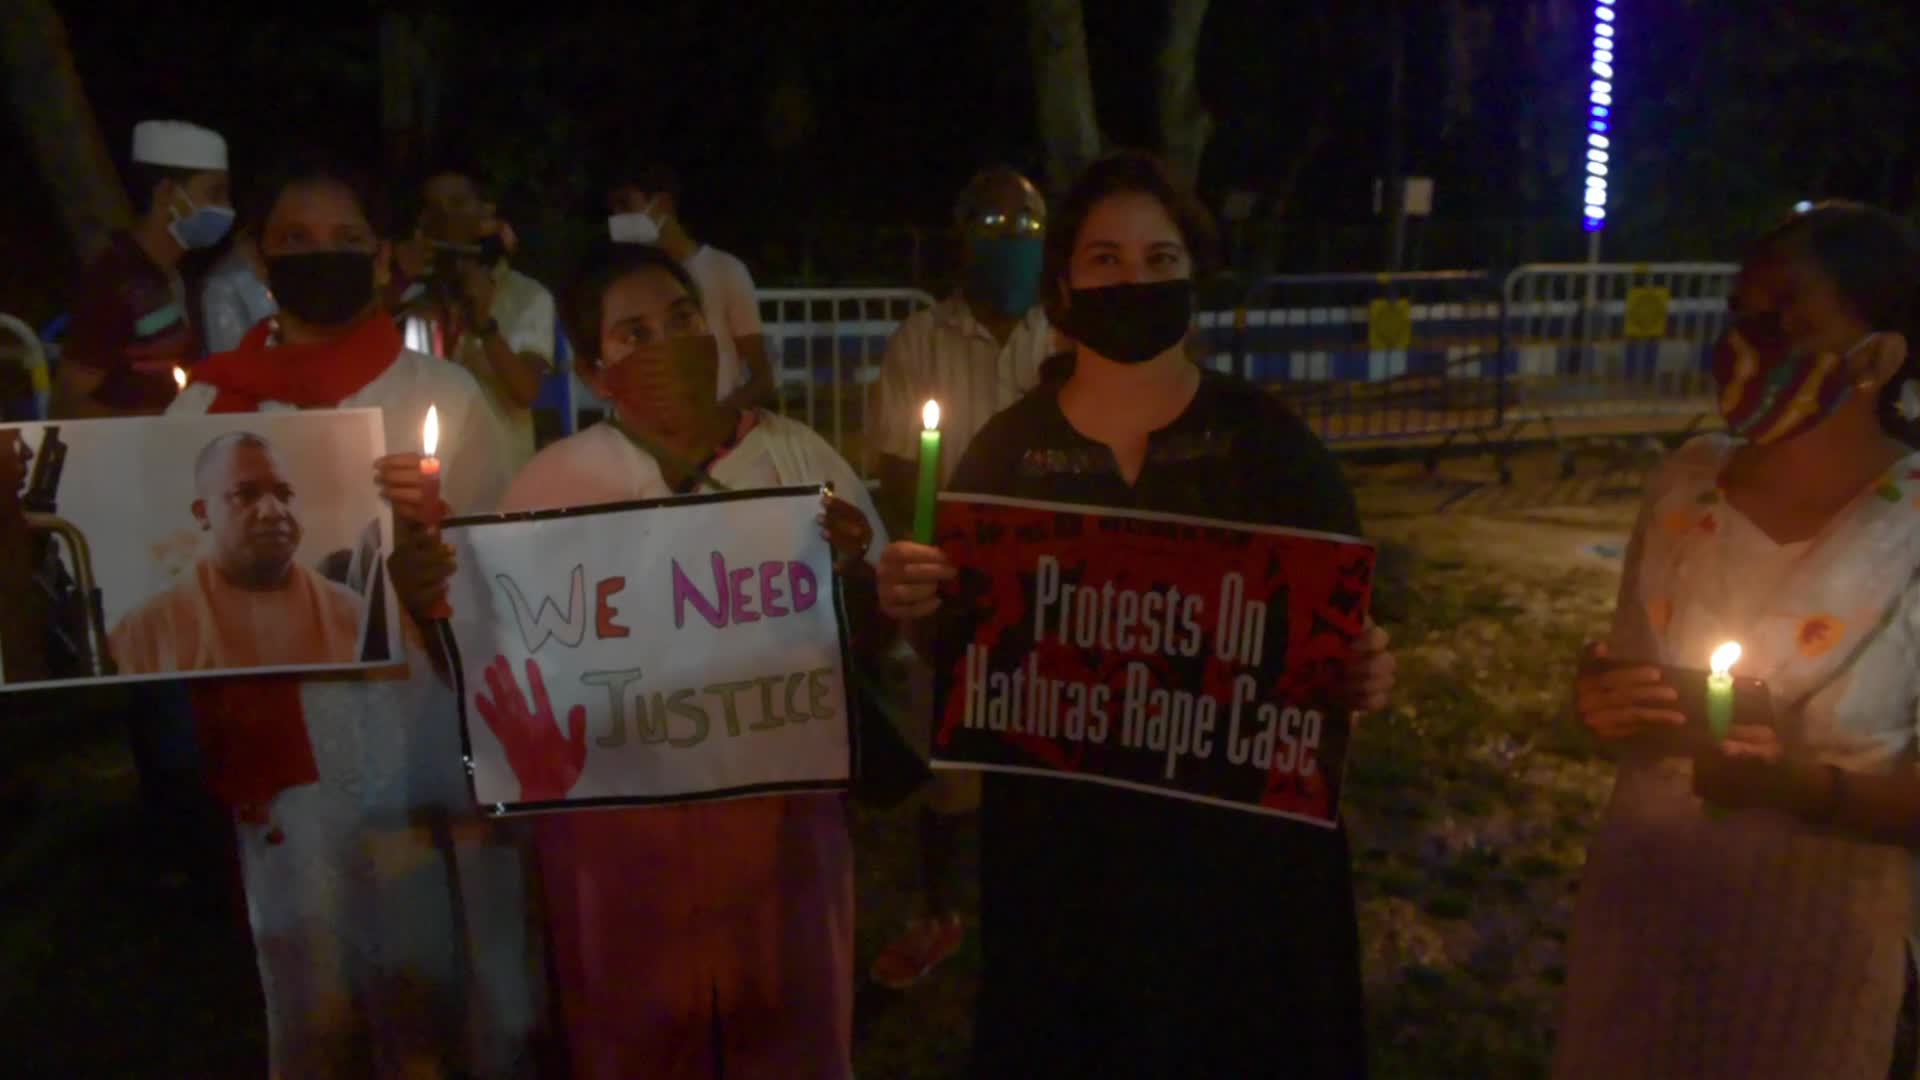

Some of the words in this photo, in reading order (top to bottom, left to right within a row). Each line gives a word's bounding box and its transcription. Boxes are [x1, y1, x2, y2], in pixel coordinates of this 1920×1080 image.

[496, 563, 631, 654] WE
[671, 550, 818, 630] NEED
[1034, 554, 1205, 657] Protests
[1216, 571, 1267, 667] On
[579, 667, 837, 748] JUSTICE
[964, 643, 1111, 743] Hathras
[1121, 661, 1217, 779] Rape
[1226, 675, 1322, 777] Case
